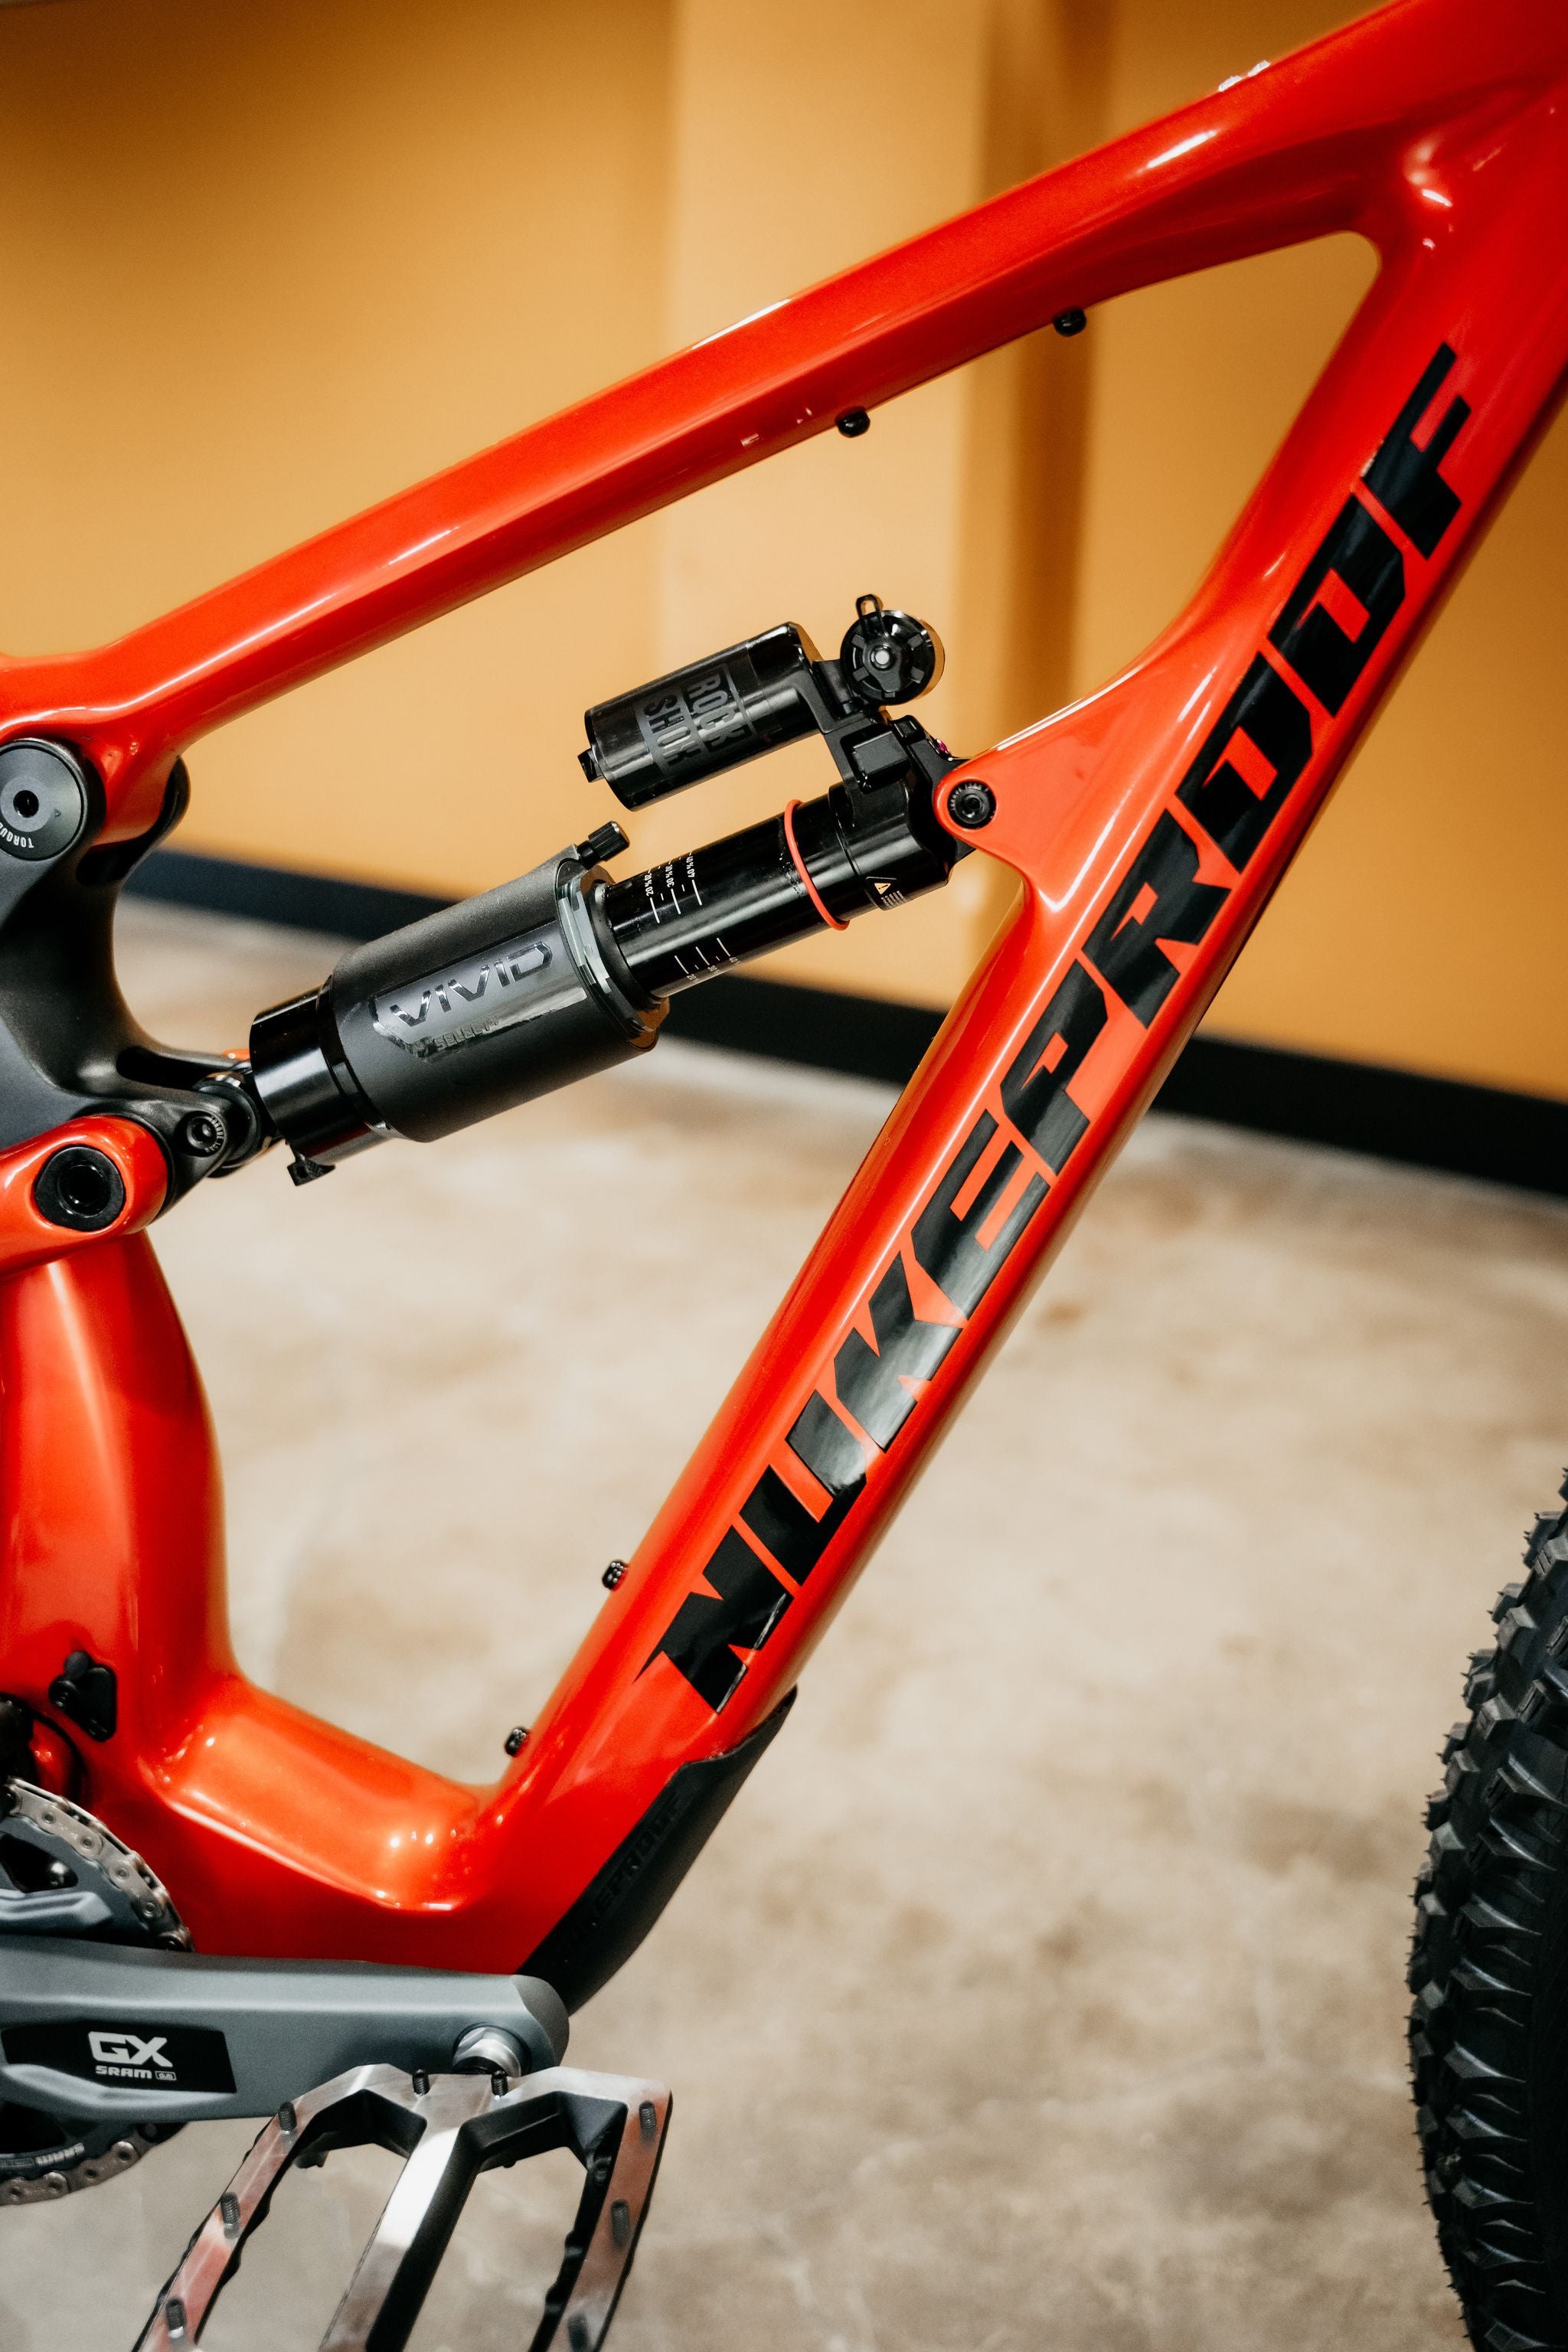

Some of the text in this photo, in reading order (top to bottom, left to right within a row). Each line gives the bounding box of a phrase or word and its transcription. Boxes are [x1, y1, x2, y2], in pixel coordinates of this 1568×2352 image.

[643, 694, 702, 766] SHOX
[687, 674, 746, 747] ROCK
[390, 941, 553, 1027] VIVID
[634, 342, 1471, 1714] NUKEPROOF
[88, 2031, 174, 2067] GX
[96, 2065, 152, 2079] SRAM
